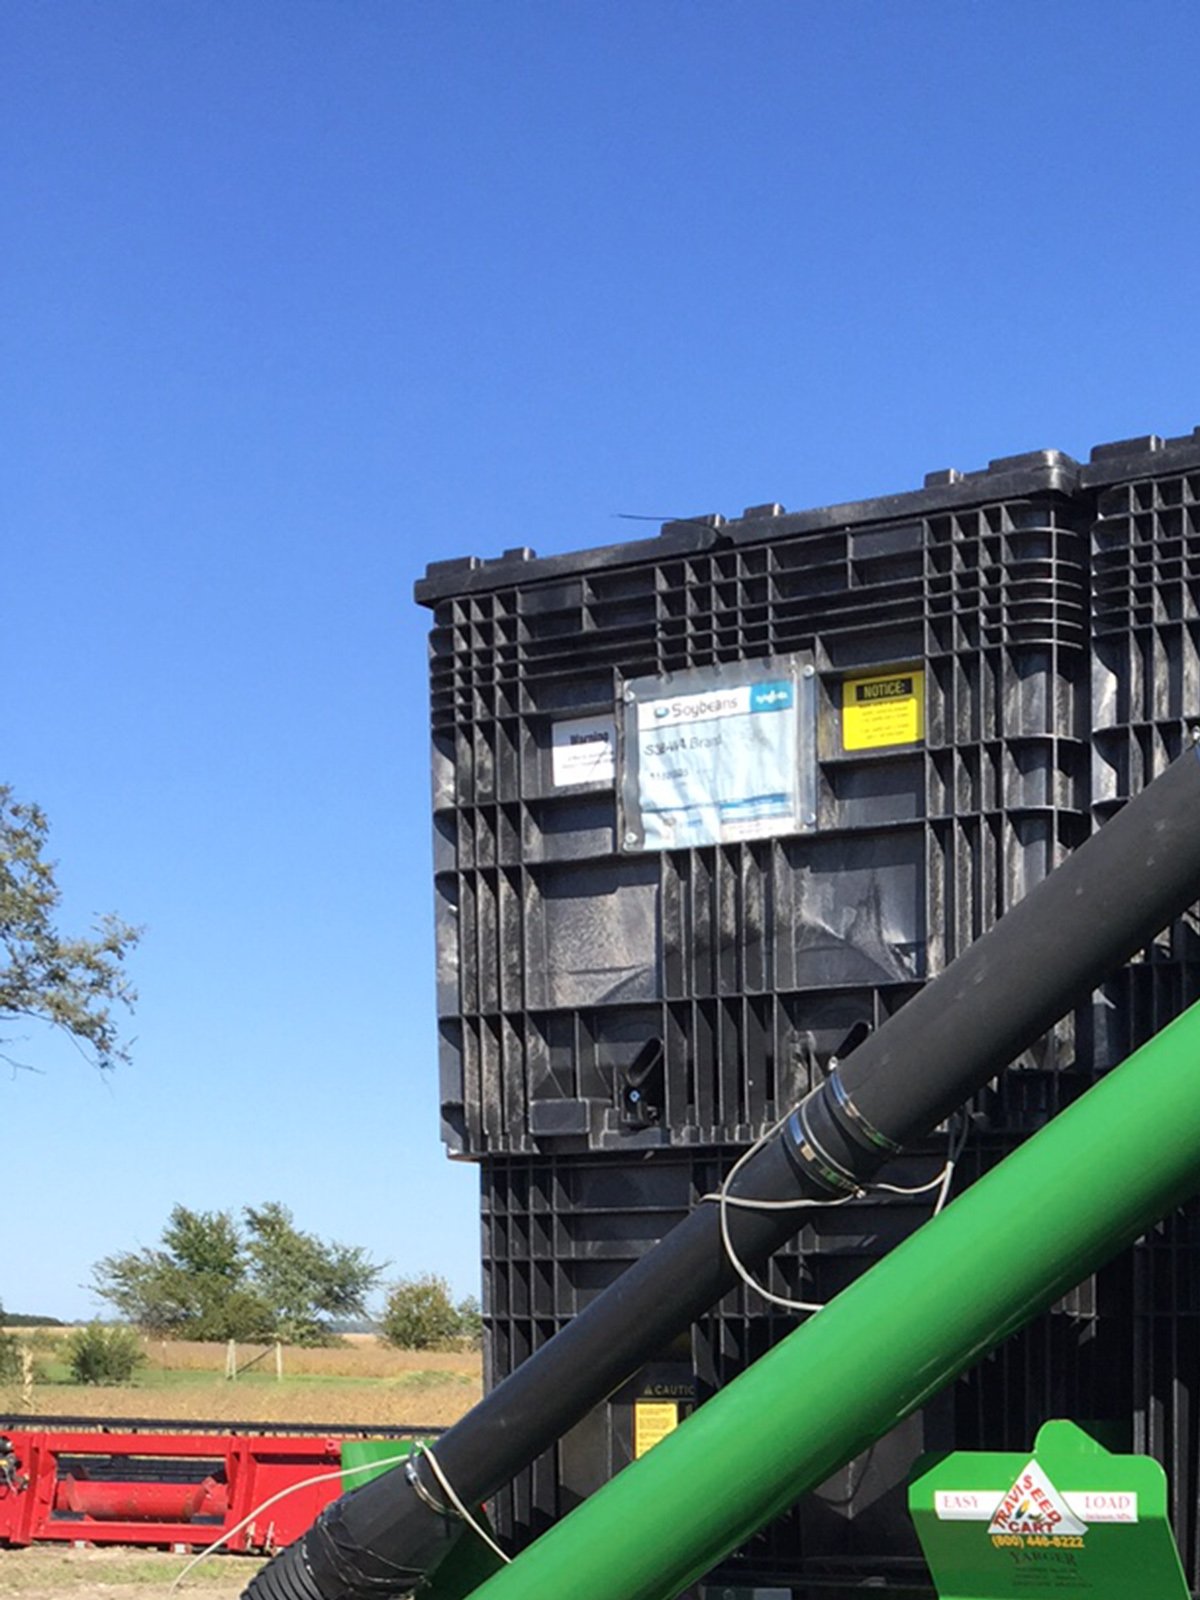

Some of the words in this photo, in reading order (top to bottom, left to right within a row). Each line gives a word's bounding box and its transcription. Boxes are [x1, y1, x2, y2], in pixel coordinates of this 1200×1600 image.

[671, 696, 739, 719] Soybeans
[654, 1385, 696, 1396] CAUTIO
[943, 1496, 979, 1509] EASY
[1085, 1495, 1131, 1509] LOAD
[1008, 1521, 1055, 1534] CART
